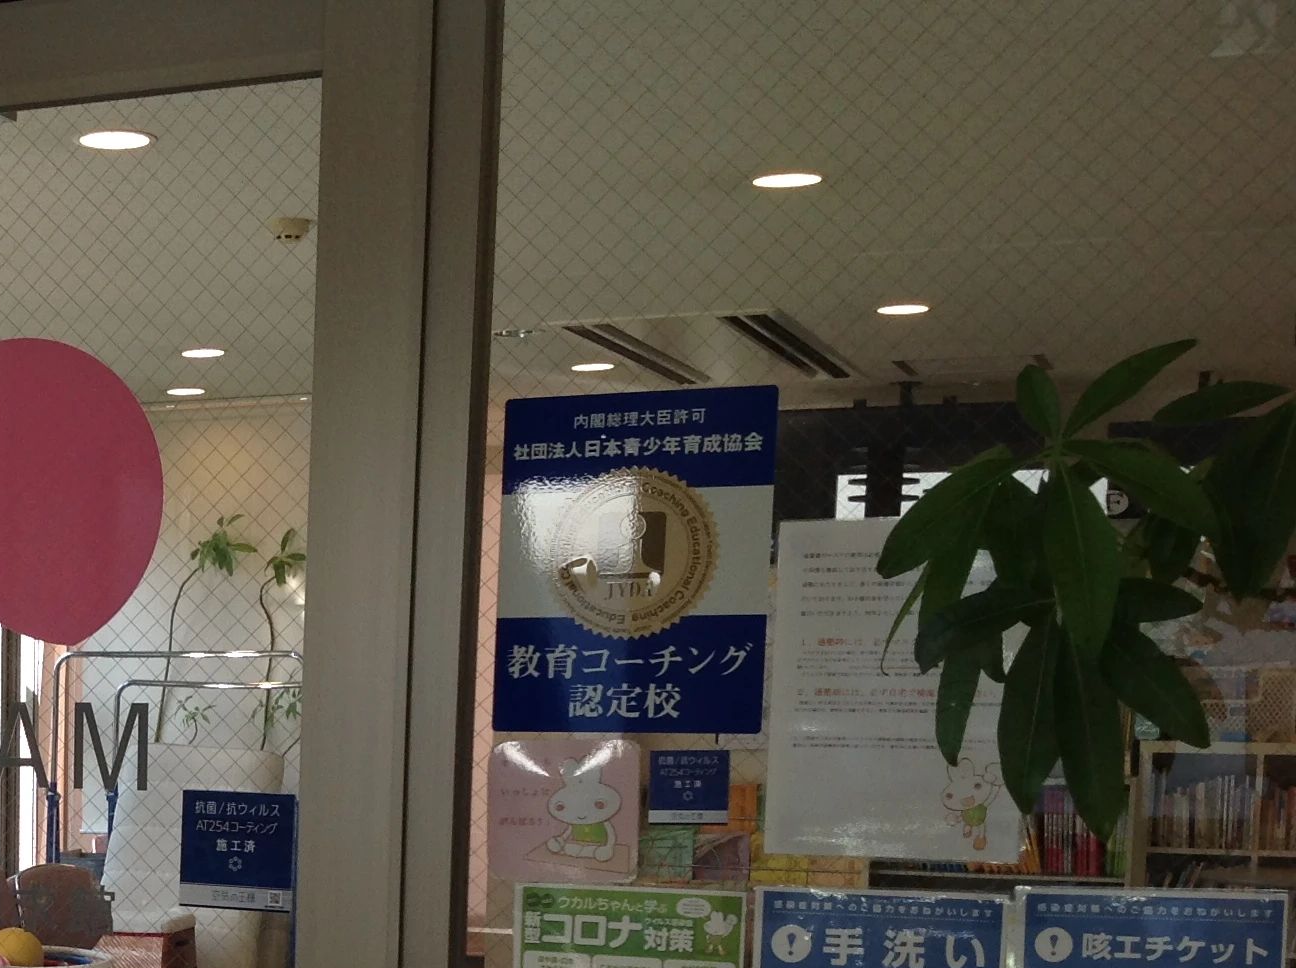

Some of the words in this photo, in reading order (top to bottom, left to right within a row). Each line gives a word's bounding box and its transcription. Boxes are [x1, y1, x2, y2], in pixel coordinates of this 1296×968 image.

[574, 407, 706, 429] 内閣総理大臣許可
[513, 431, 764, 461] 社団法人日本青少年育成協会
[507, 642, 753, 680] 教育コーチング
[567, 683, 682, 719] 認定校
[194, 800, 281, 817] 抗菌/抗ウィルス
[195, 819, 279, 835] AT254コーティング
[215, 838, 256, 853] 施工済
[541, 914, 643, 949] コロナ
[644, 927, 695, 953] 対策
[1082, 932, 1269, 966] 咳エチケット
